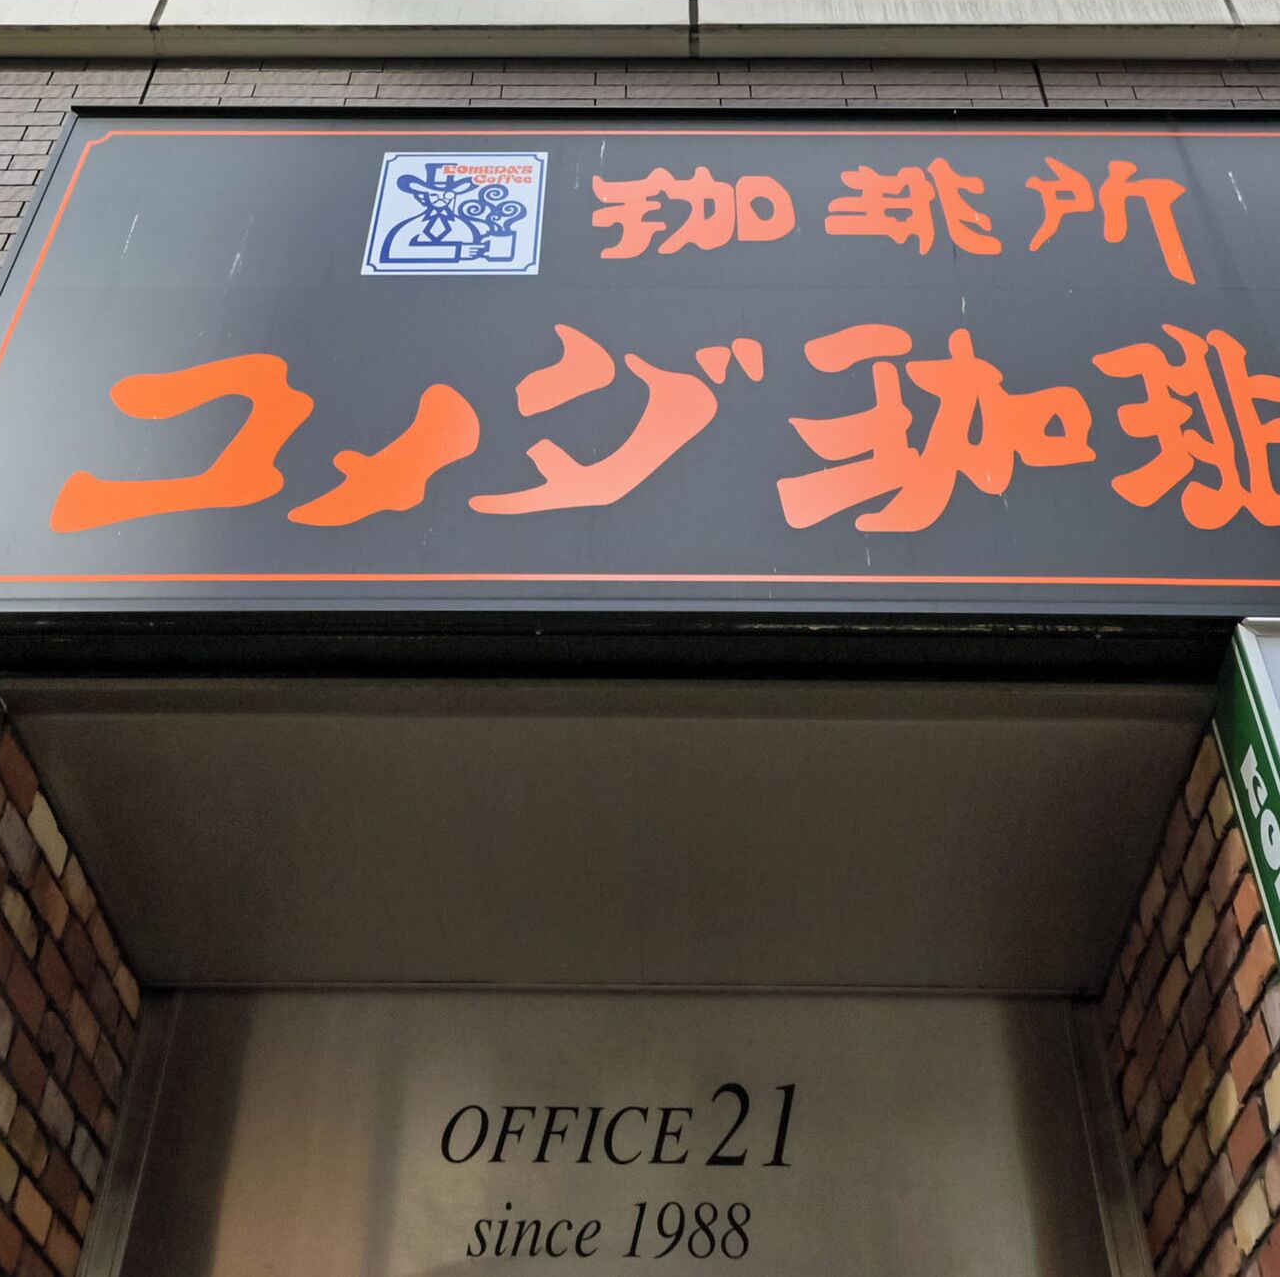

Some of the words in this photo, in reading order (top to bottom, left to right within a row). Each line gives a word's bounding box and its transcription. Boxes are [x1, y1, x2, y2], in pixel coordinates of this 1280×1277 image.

[473, 174, 532, 185] Coffee
[593, 157, 1197, 285] 珈琲所
[439, 1104, 694, 1165] OFFICE
[705, 1081, 797, 1167] 21
[465, 1201, 602, 1259] since
[622, 1200, 752, 1260] 1988
